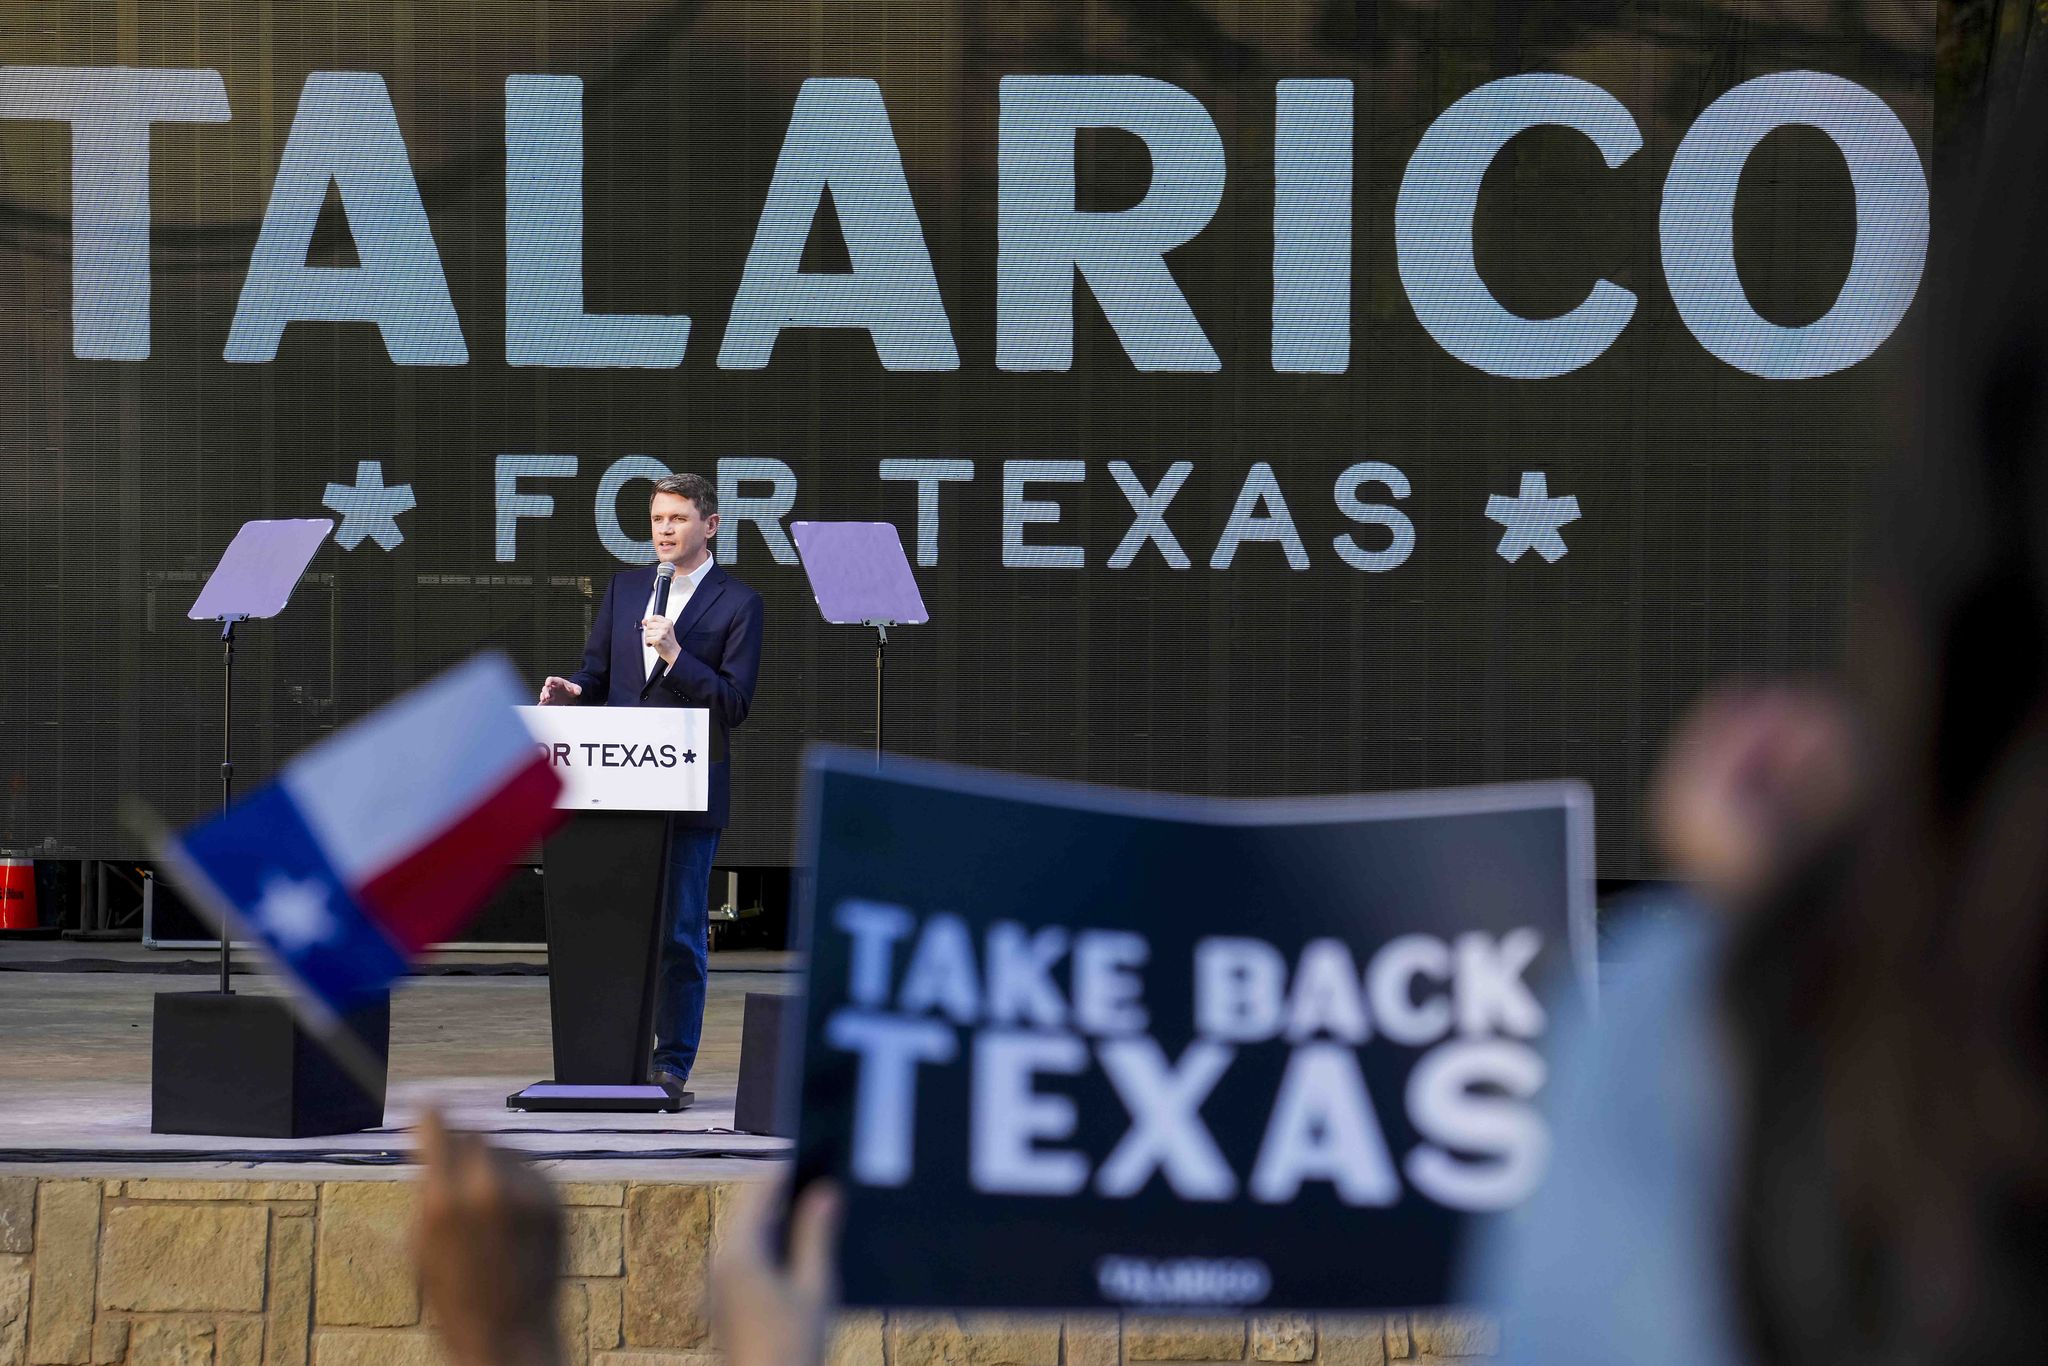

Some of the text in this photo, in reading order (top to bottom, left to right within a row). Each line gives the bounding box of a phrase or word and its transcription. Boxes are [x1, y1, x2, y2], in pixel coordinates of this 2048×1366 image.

[0, 65, 1931, 381] TALARICO
[495, 454, 1417, 573] FOR TEXAS
[579, 743, 677, 768] TEXAS
[833, 898, 1546, 1046] TAKE BACK
[825, 1012, 1550, 1213] TEXAS
